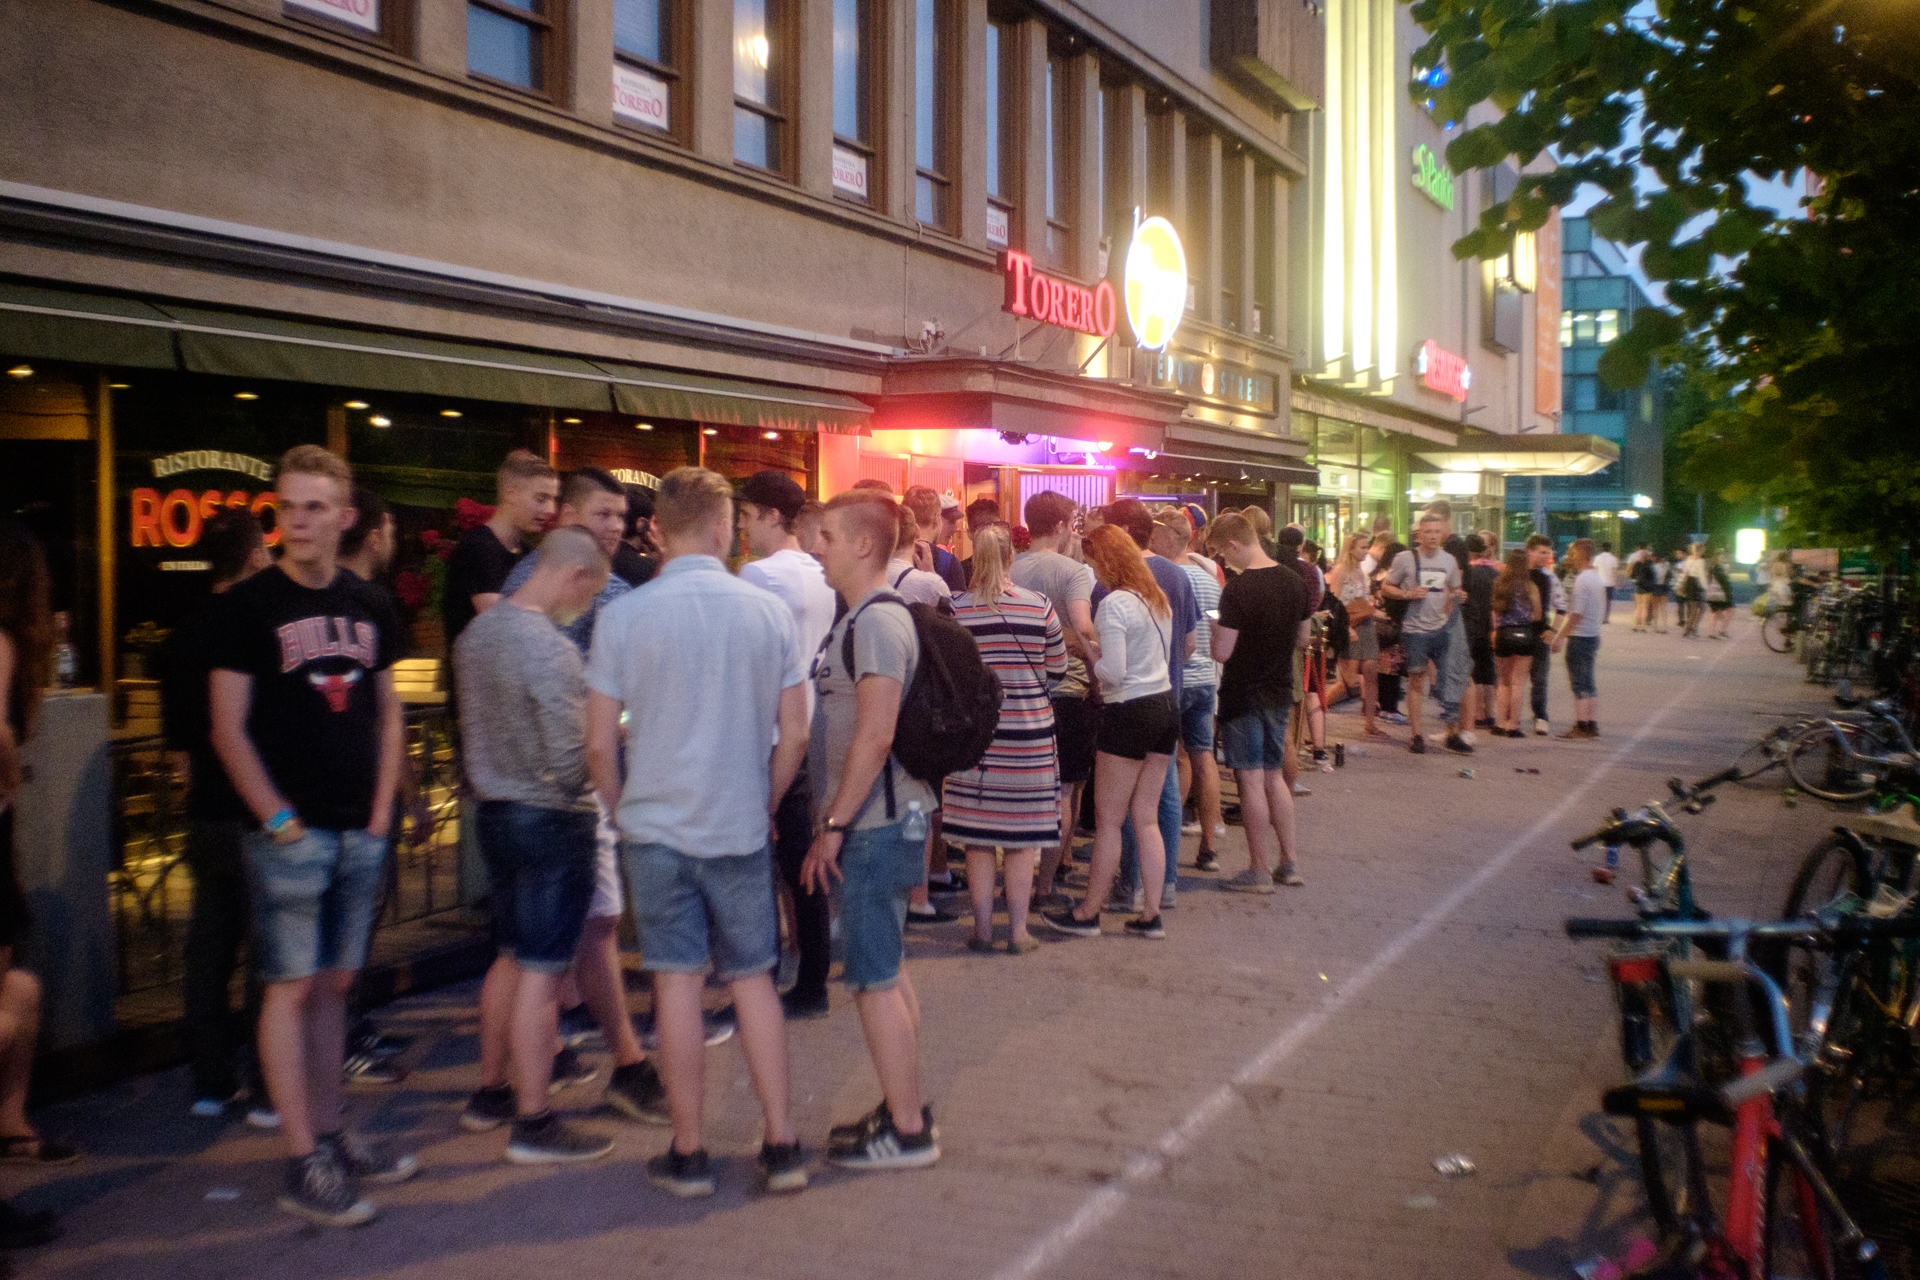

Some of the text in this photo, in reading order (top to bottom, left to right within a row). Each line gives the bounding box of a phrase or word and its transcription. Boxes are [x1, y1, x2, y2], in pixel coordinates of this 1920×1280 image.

[613, 83, 663, 118] TORERO
[833, 167, 864, 188] ORERO
[987, 223, 1006, 239] RERO
[1006, 249, 1116, 338] TORERO
[152, 450, 273, 482] RISTORANTE
[610, 468, 663, 492] TORANTE
[131, 487, 282, 548] ROO
[278, 616, 376, 673] BULLS
